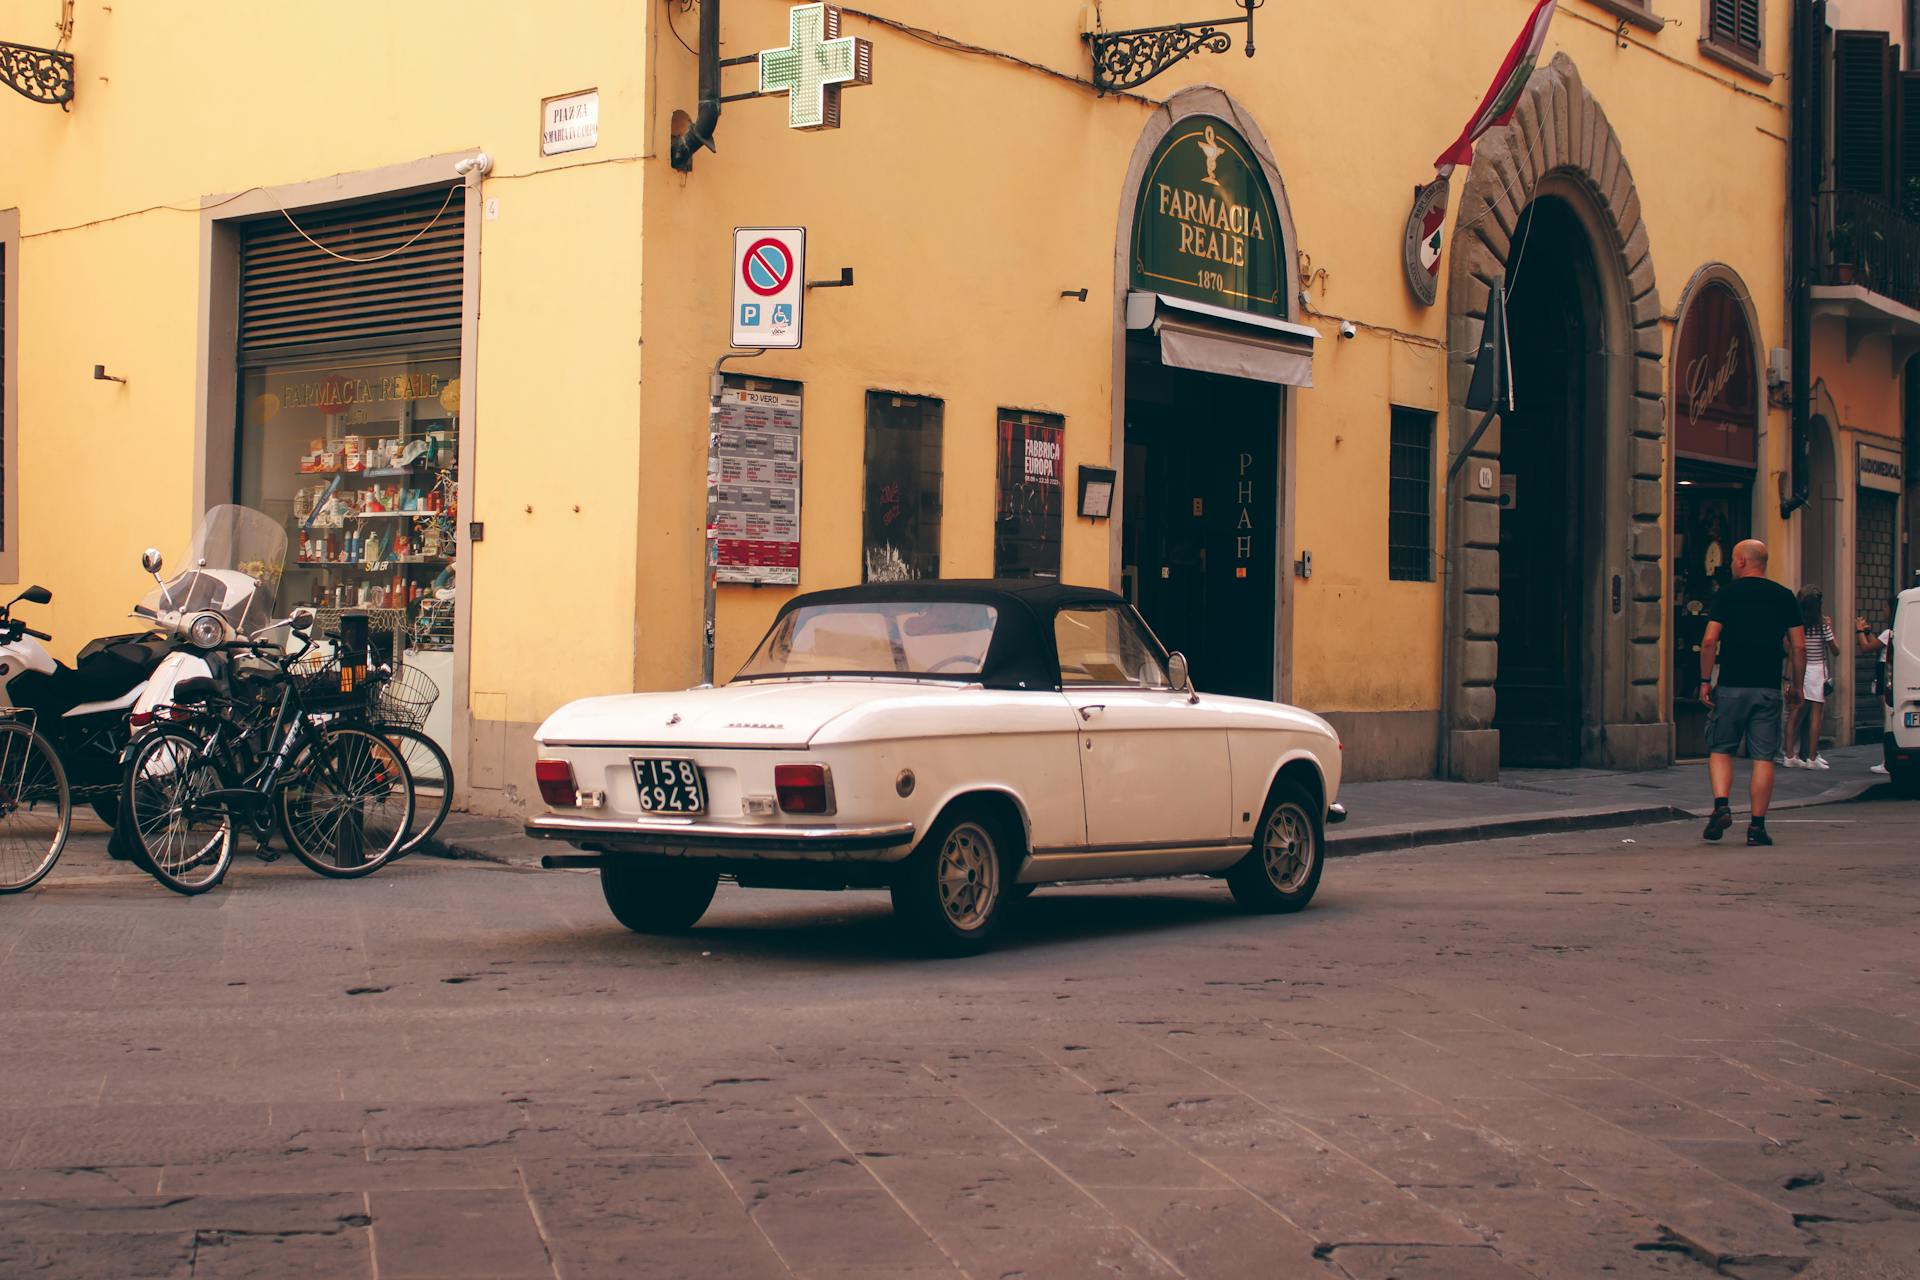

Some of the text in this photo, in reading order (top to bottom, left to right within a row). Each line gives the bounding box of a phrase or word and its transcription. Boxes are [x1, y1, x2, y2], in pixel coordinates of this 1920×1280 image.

[553, 103, 589, 124] PIAZZA
[1157, 182, 1265, 241] FARMACIA
[1178, 222, 1244, 267] REALE
[1198, 270, 1224, 293] 1870
[744, 306, 756, 324] P
[281, 373, 441, 409] FARMACIA REALE
[759, 394, 779, 404] VERDI
[1025, 438, 1060, 461] FABBRICA
[1024, 456, 1054, 477] EUROPA
[639, 785, 700, 812] 6943
